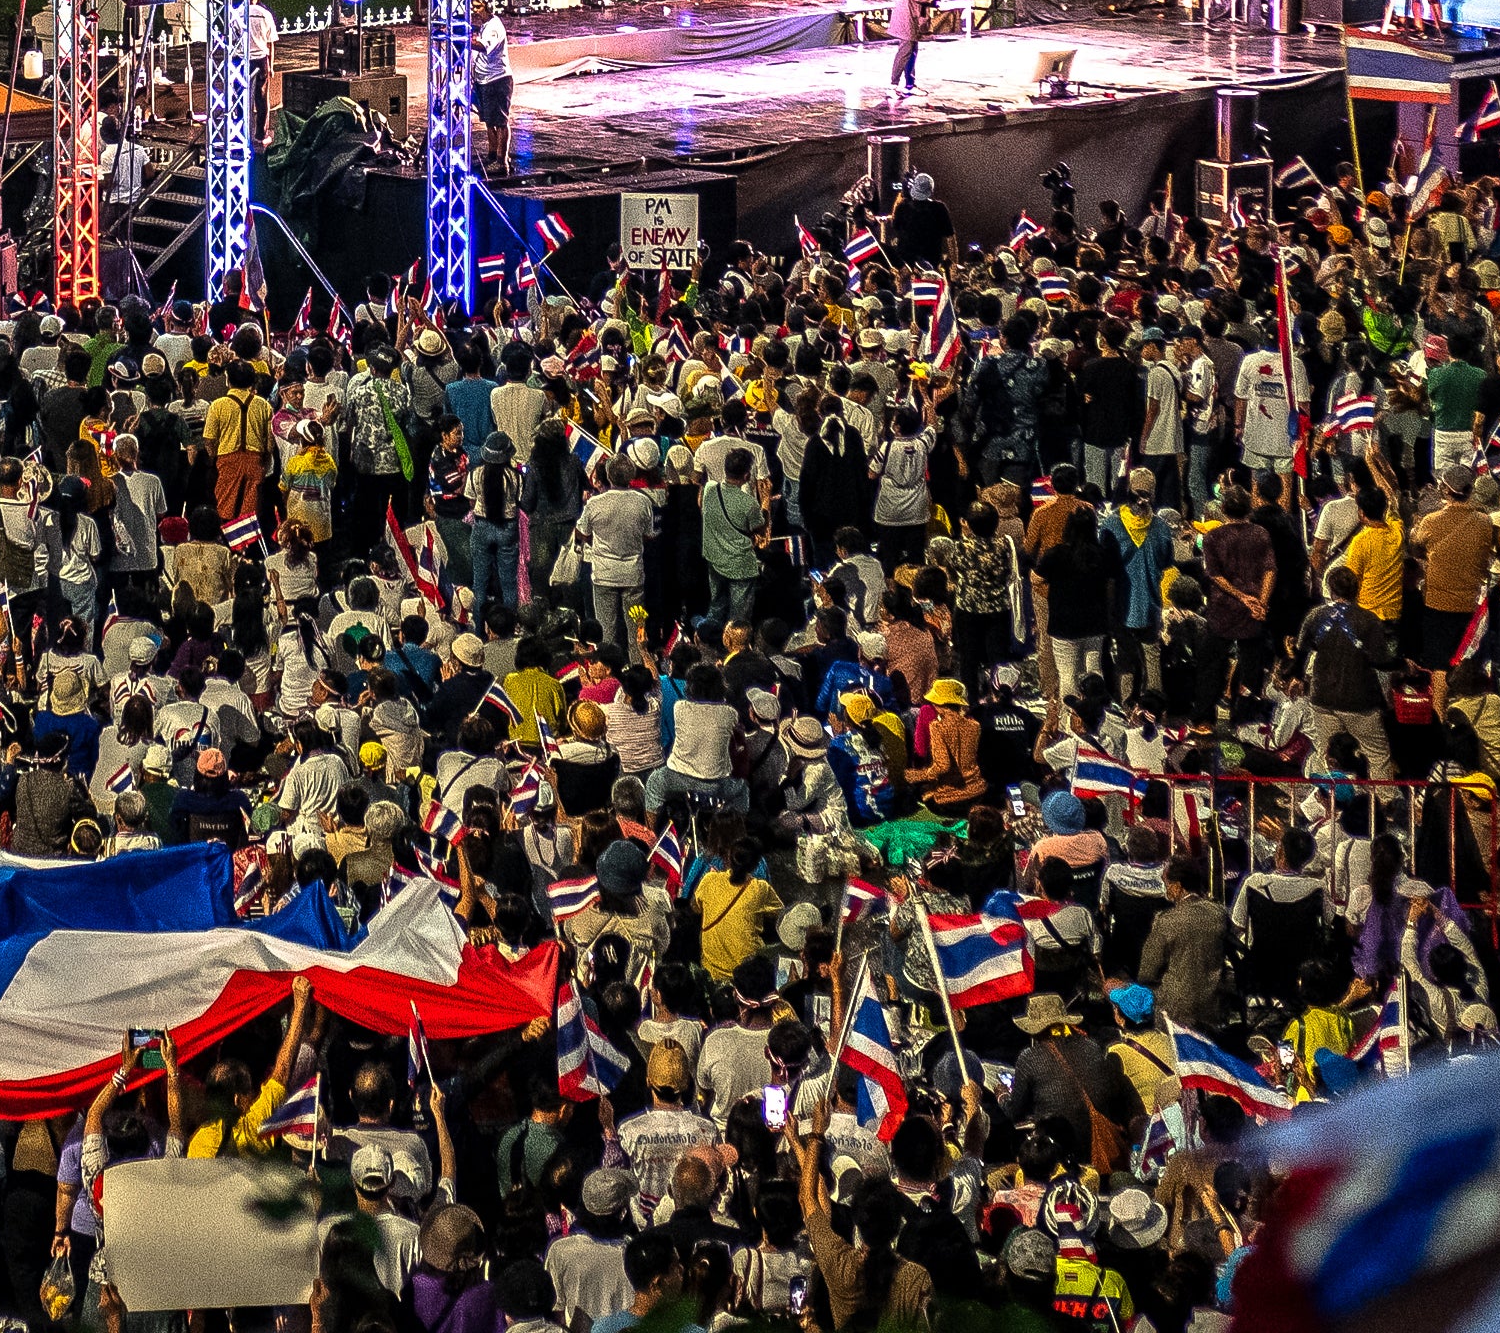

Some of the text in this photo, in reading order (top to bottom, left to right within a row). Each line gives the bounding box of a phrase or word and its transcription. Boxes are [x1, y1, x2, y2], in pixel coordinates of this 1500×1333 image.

[645, 197, 672, 215] PM
[631, 227, 690, 246] ENEMY
[628, 247, 695, 267] OF STATE
